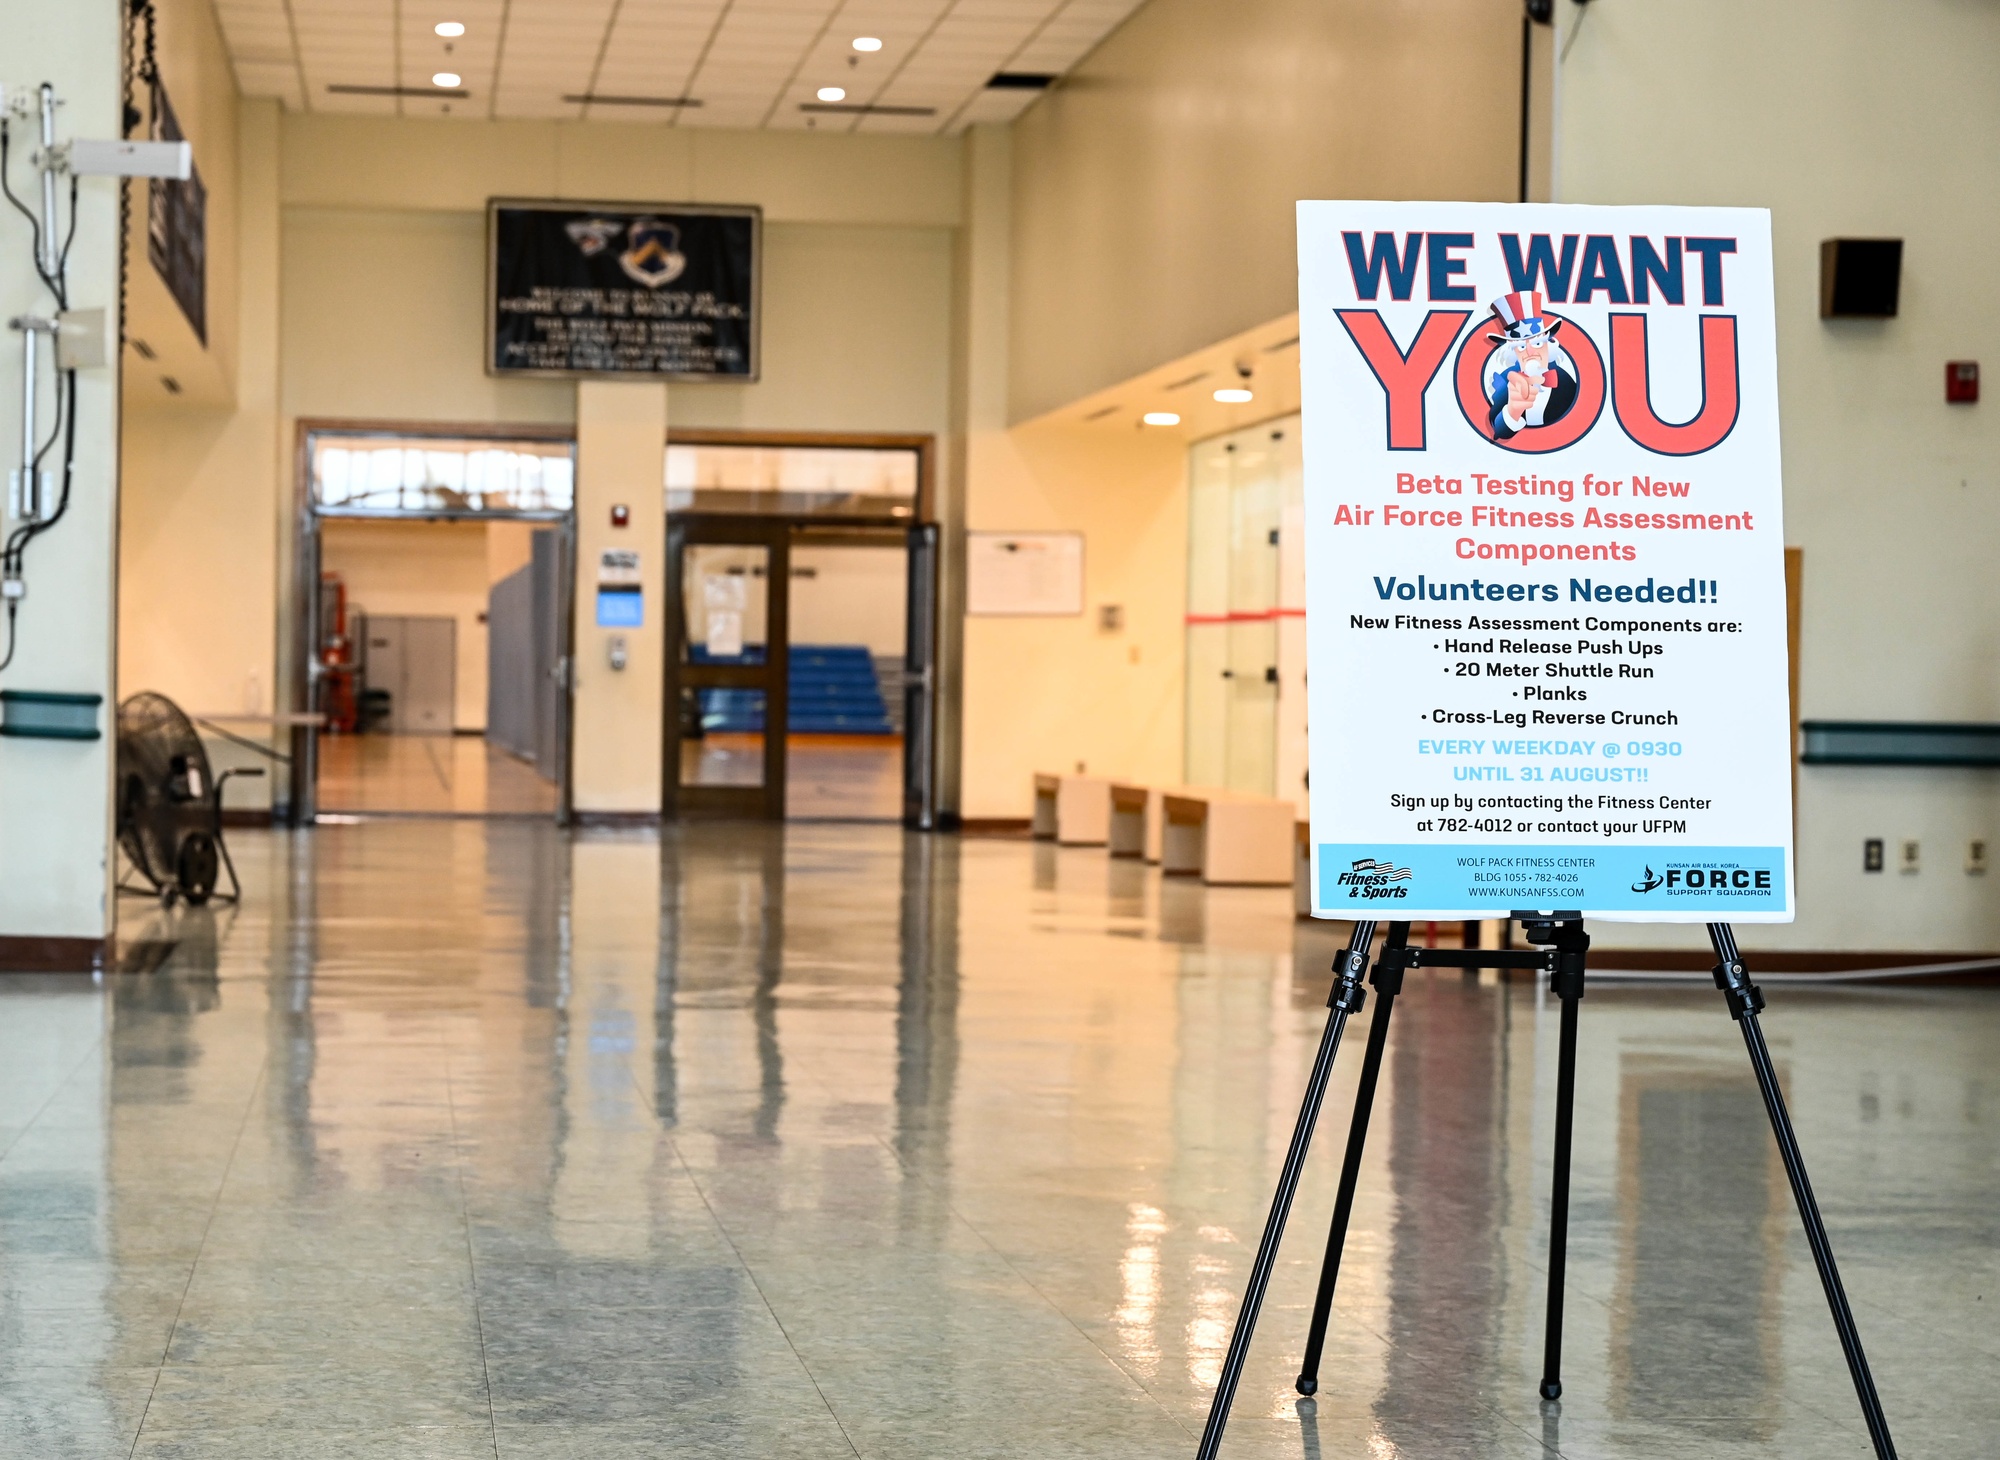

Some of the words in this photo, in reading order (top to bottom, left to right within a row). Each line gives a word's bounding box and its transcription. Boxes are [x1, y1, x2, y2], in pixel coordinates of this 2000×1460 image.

[1340, 230, 1476, 302] WE
[1497, 232, 1738, 307] WANT
[1332, 307, 1741, 458] YOU
[1397, 473, 1462, 494] Beta
[1471, 474, 1573, 501] Testing
[1583, 474, 1623, 496] for
[1632, 476, 1690, 497] New
[1334, 505, 1374, 525] Air
[1384, 505, 1462, 526] Force
[1472, 506, 1574, 528] Fitness
[1583, 507, 1753, 530] Assessment
[1456, 538, 1636, 565] Components
[1373, 575, 1558, 602] Volunteers
[1570, 578, 1717, 603] Needed!!
[1351, 615, 1389, 628] New
[1395, 615, 1462, 629] Fitness
[1468, 616, 1579, 630] Assessment
[1586, 617, 1702, 634] Components
[1708, 621, 1742, 632] are:
[1445, 638, 1493, 653] Hand
[1500, 639, 1571, 653] Release
[1578, 640, 1622, 654] Push
[1629, 641, 1663, 657] Ups
[1456, 662, 1480, 676] 20
[1487, 663, 1539, 677] Meter
[1546, 662, 1613, 677] Shuttle
[1619, 664, 1653, 678] Run
[1524, 686, 1587, 700] Planks
[1433, 709, 1526, 728] Cross-Leg
[1533, 710, 1605, 724] Reverse
[1612, 710, 1677, 725] Crunch
[1419, 740, 1485, 754] EVERY
[1492, 740, 1595, 755] WEEKDAY
[1602, 743, 1620, 758] @
[1627, 741, 1682, 756] 0930
[1454, 767, 1514, 781] UNTIL
[1521, 767, 1544, 781] 31
[1550, 767, 1648, 782] AUGUST!!
[1391, 794, 1425, 811] Sign
[1431, 798, 1449, 811] up
[1455, 794, 1472, 811] by
[1479, 795, 1562, 812] contacting
[1568, 794, 1593, 808] the
[1599, 796, 1654, 809] Fitness
[1660, 796, 1711, 809] Center
[1418, 820, 1433, 831] at
[1438, 819, 1512, 832] 782-4012
[1518, 823, 1533, 832] or
[1538, 821, 1598, 832] contact
[1604, 823, 1638, 836] your
[1643, 820, 1685, 833] UFPM
[1456, 857, 1486, 867] WOLF
[1488, 857, 1514, 867] PACK
[1515, 857, 1555, 868] FITNESS
[1557, 857, 1595, 868] CENTER
[1337, 872, 1389, 886] Fitness
[1474, 872, 1502, 882] BLDG
[1504, 873, 1527, 882] 1055
[1534, 873, 1579, 883] 782-4026
[1666, 869, 1771, 889] FORCE
[1349, 886, 1359, 898] &
[1362, 885, 1408, 900] Sports
[1468, 887, 1585, 898] WWW.KUNSANFSS.COM
[1716, 889, 1771, 897] SQUADRON
